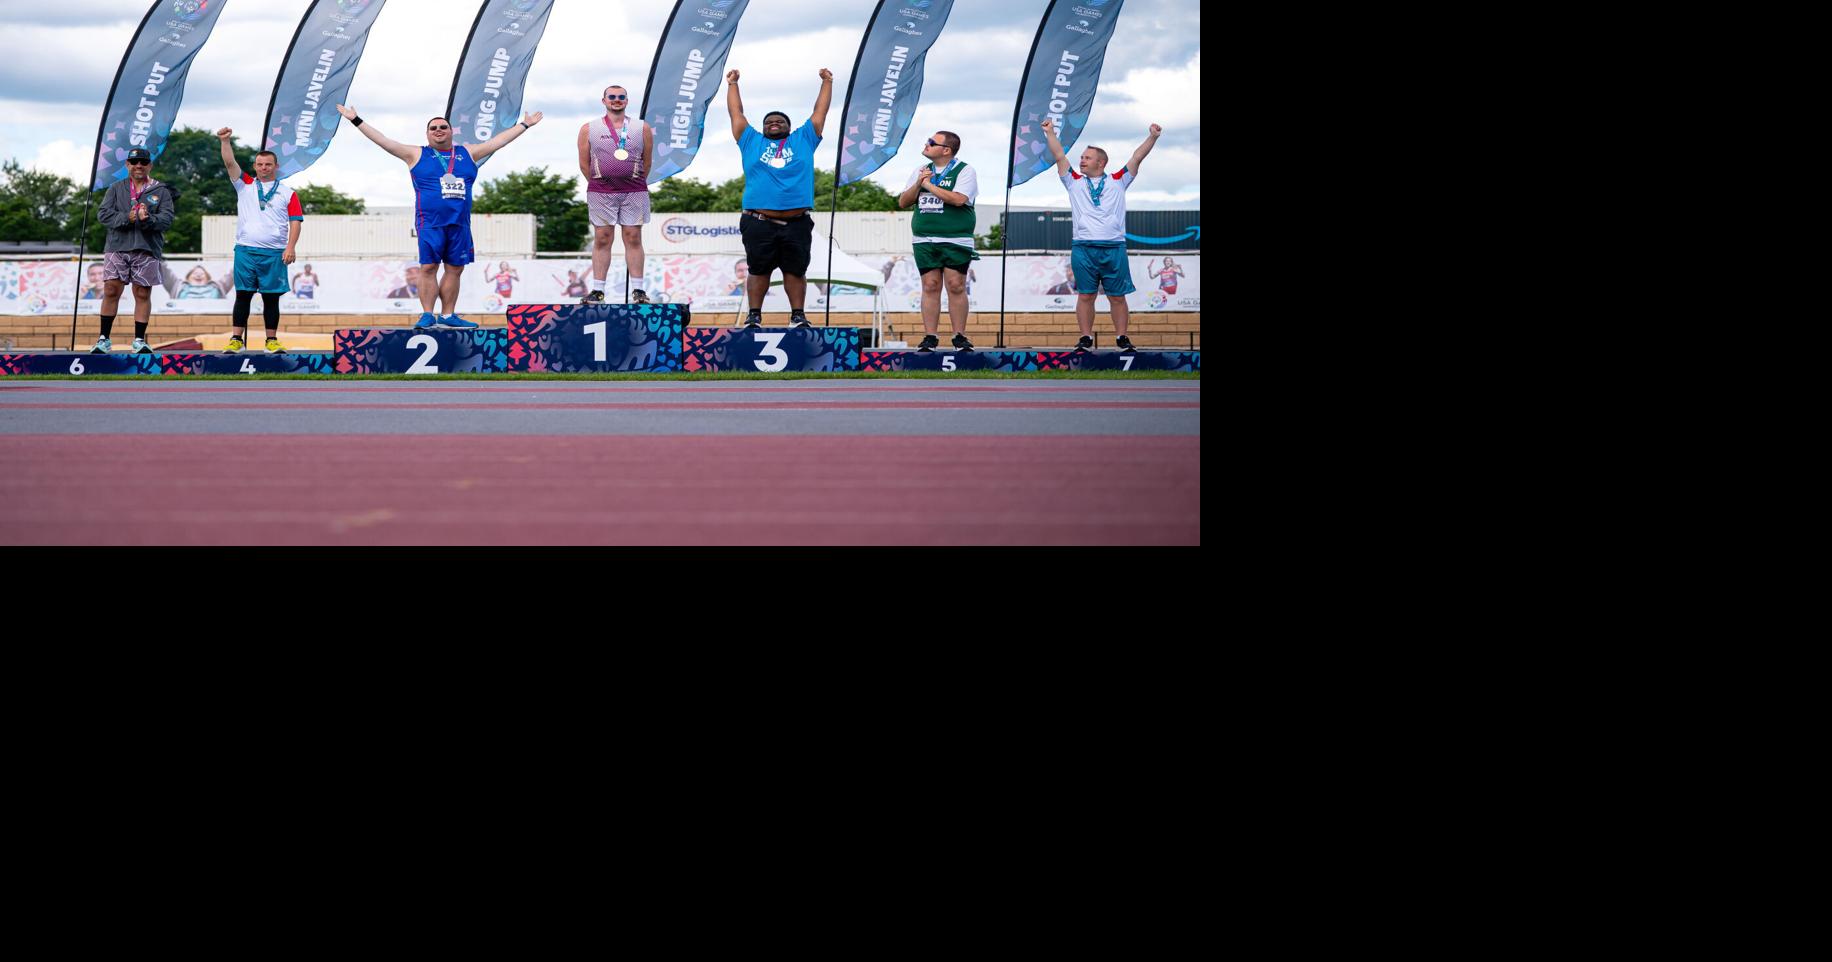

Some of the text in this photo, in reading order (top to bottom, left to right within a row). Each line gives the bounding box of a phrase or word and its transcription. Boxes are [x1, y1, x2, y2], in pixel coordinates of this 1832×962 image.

[1055, 49, 1080, 87] PUT
[129, 61, 170, 147] SHOT PUT
[295, 48, 336, 147] MINI JAVELIN
[474, 47, 511, 141] ONG JUMP
[669, 48, 705, 149] HIGH JUMP
[872, 45, 909, 147] MINI JAVELIN
[666, 225, 742, 237] STGLogistic
[405, 334, 439, 374] 2
[583, 321, 607, 362] 1
[753, 332, 788, 373] 3
[69, 357, 85, 375] 6
[239, 358, 257, 375] 4
[941, 355, 957, 372] 5
[1119, 355, 1135, 372] 7
